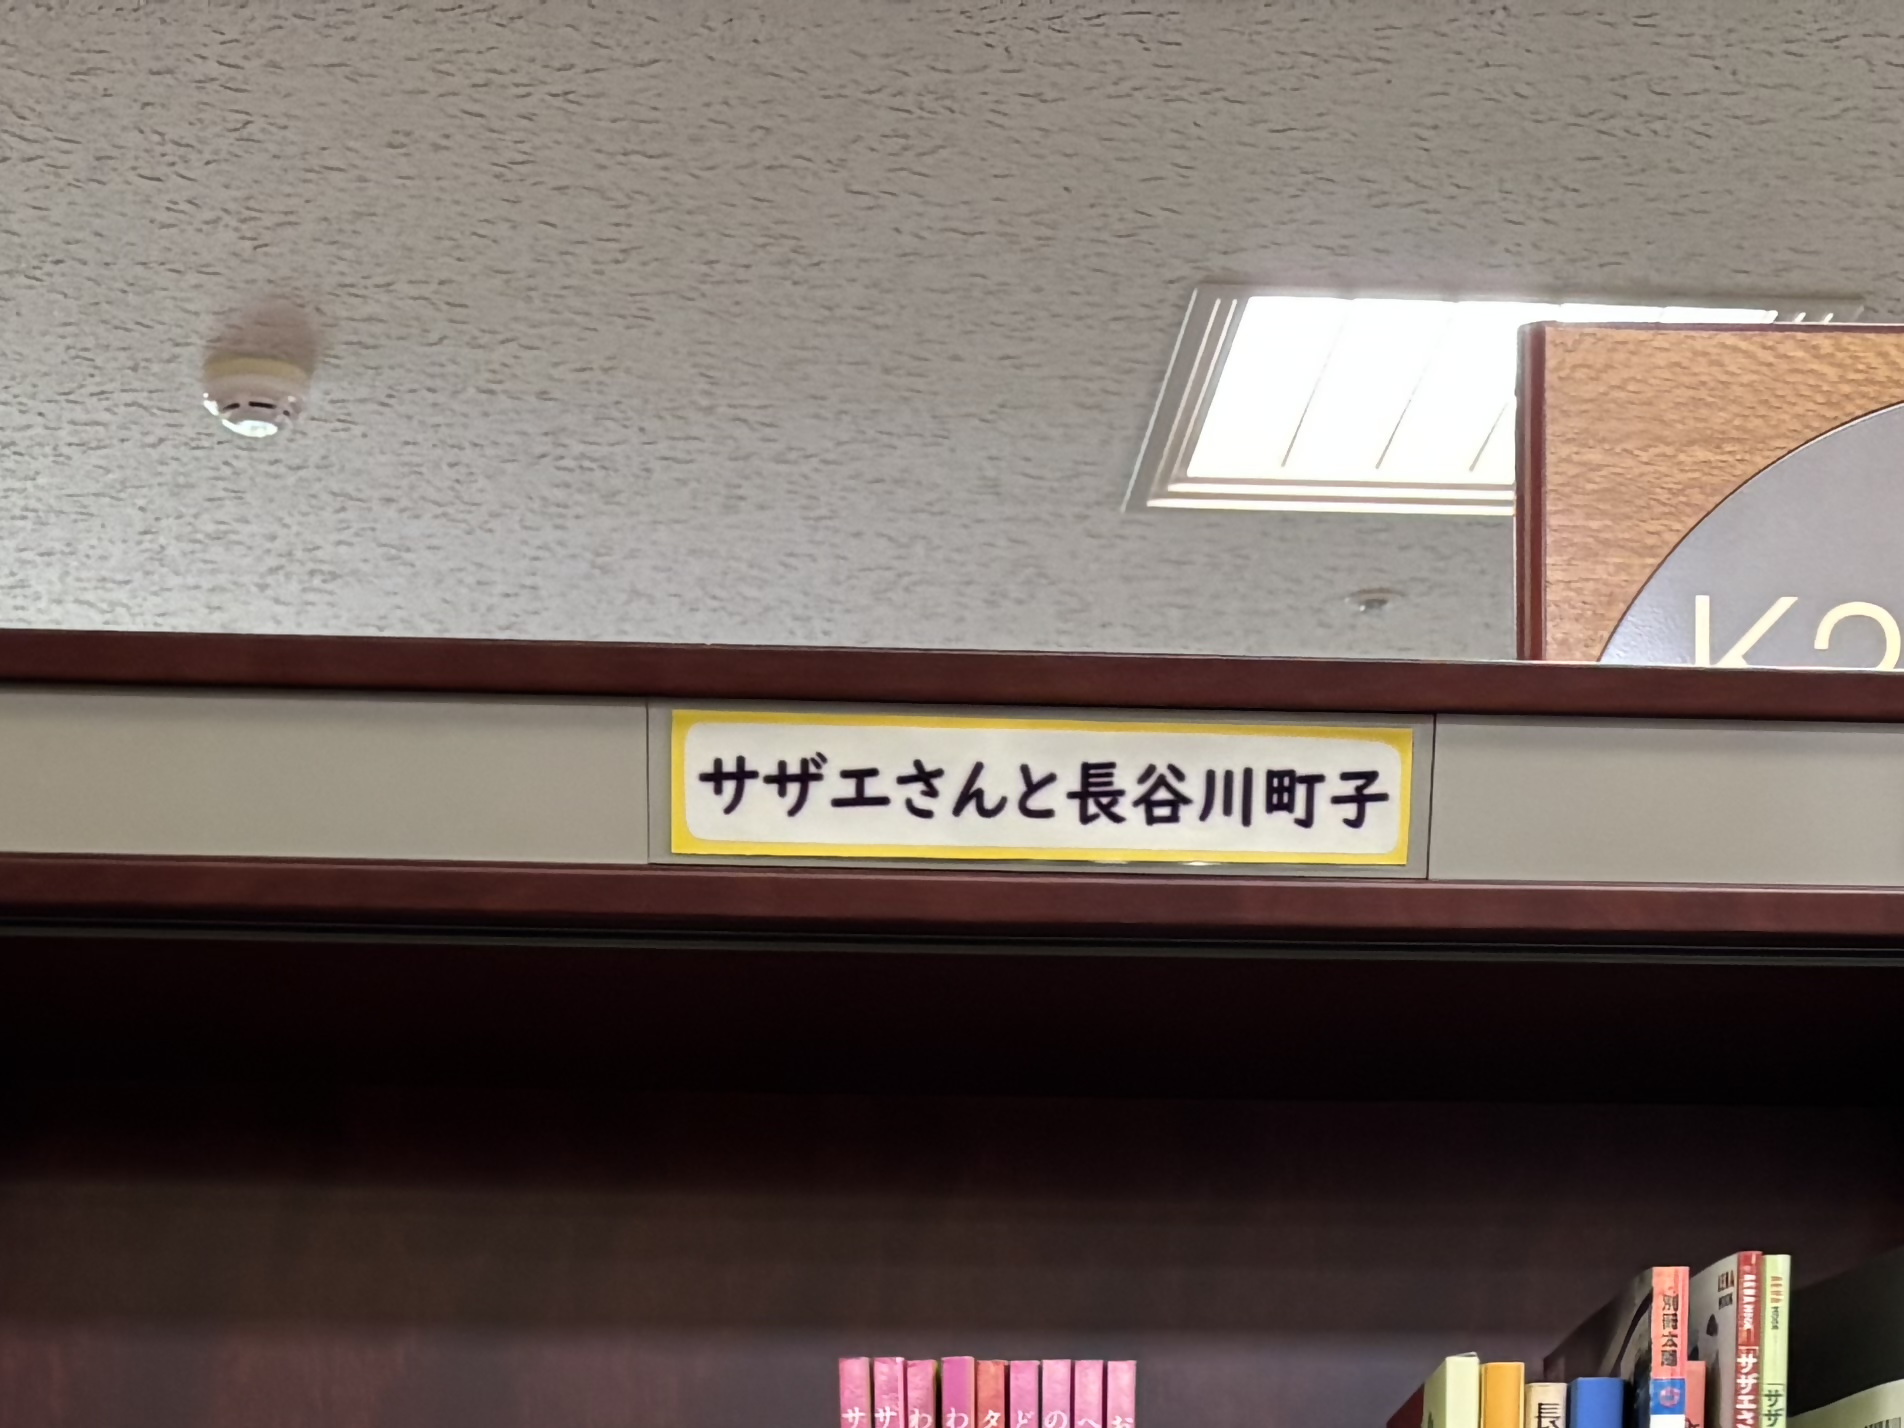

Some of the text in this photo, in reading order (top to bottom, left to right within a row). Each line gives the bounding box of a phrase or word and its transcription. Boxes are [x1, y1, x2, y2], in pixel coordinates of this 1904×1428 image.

[698, 752, 1390, 830] サザエさんと長谷川町子
